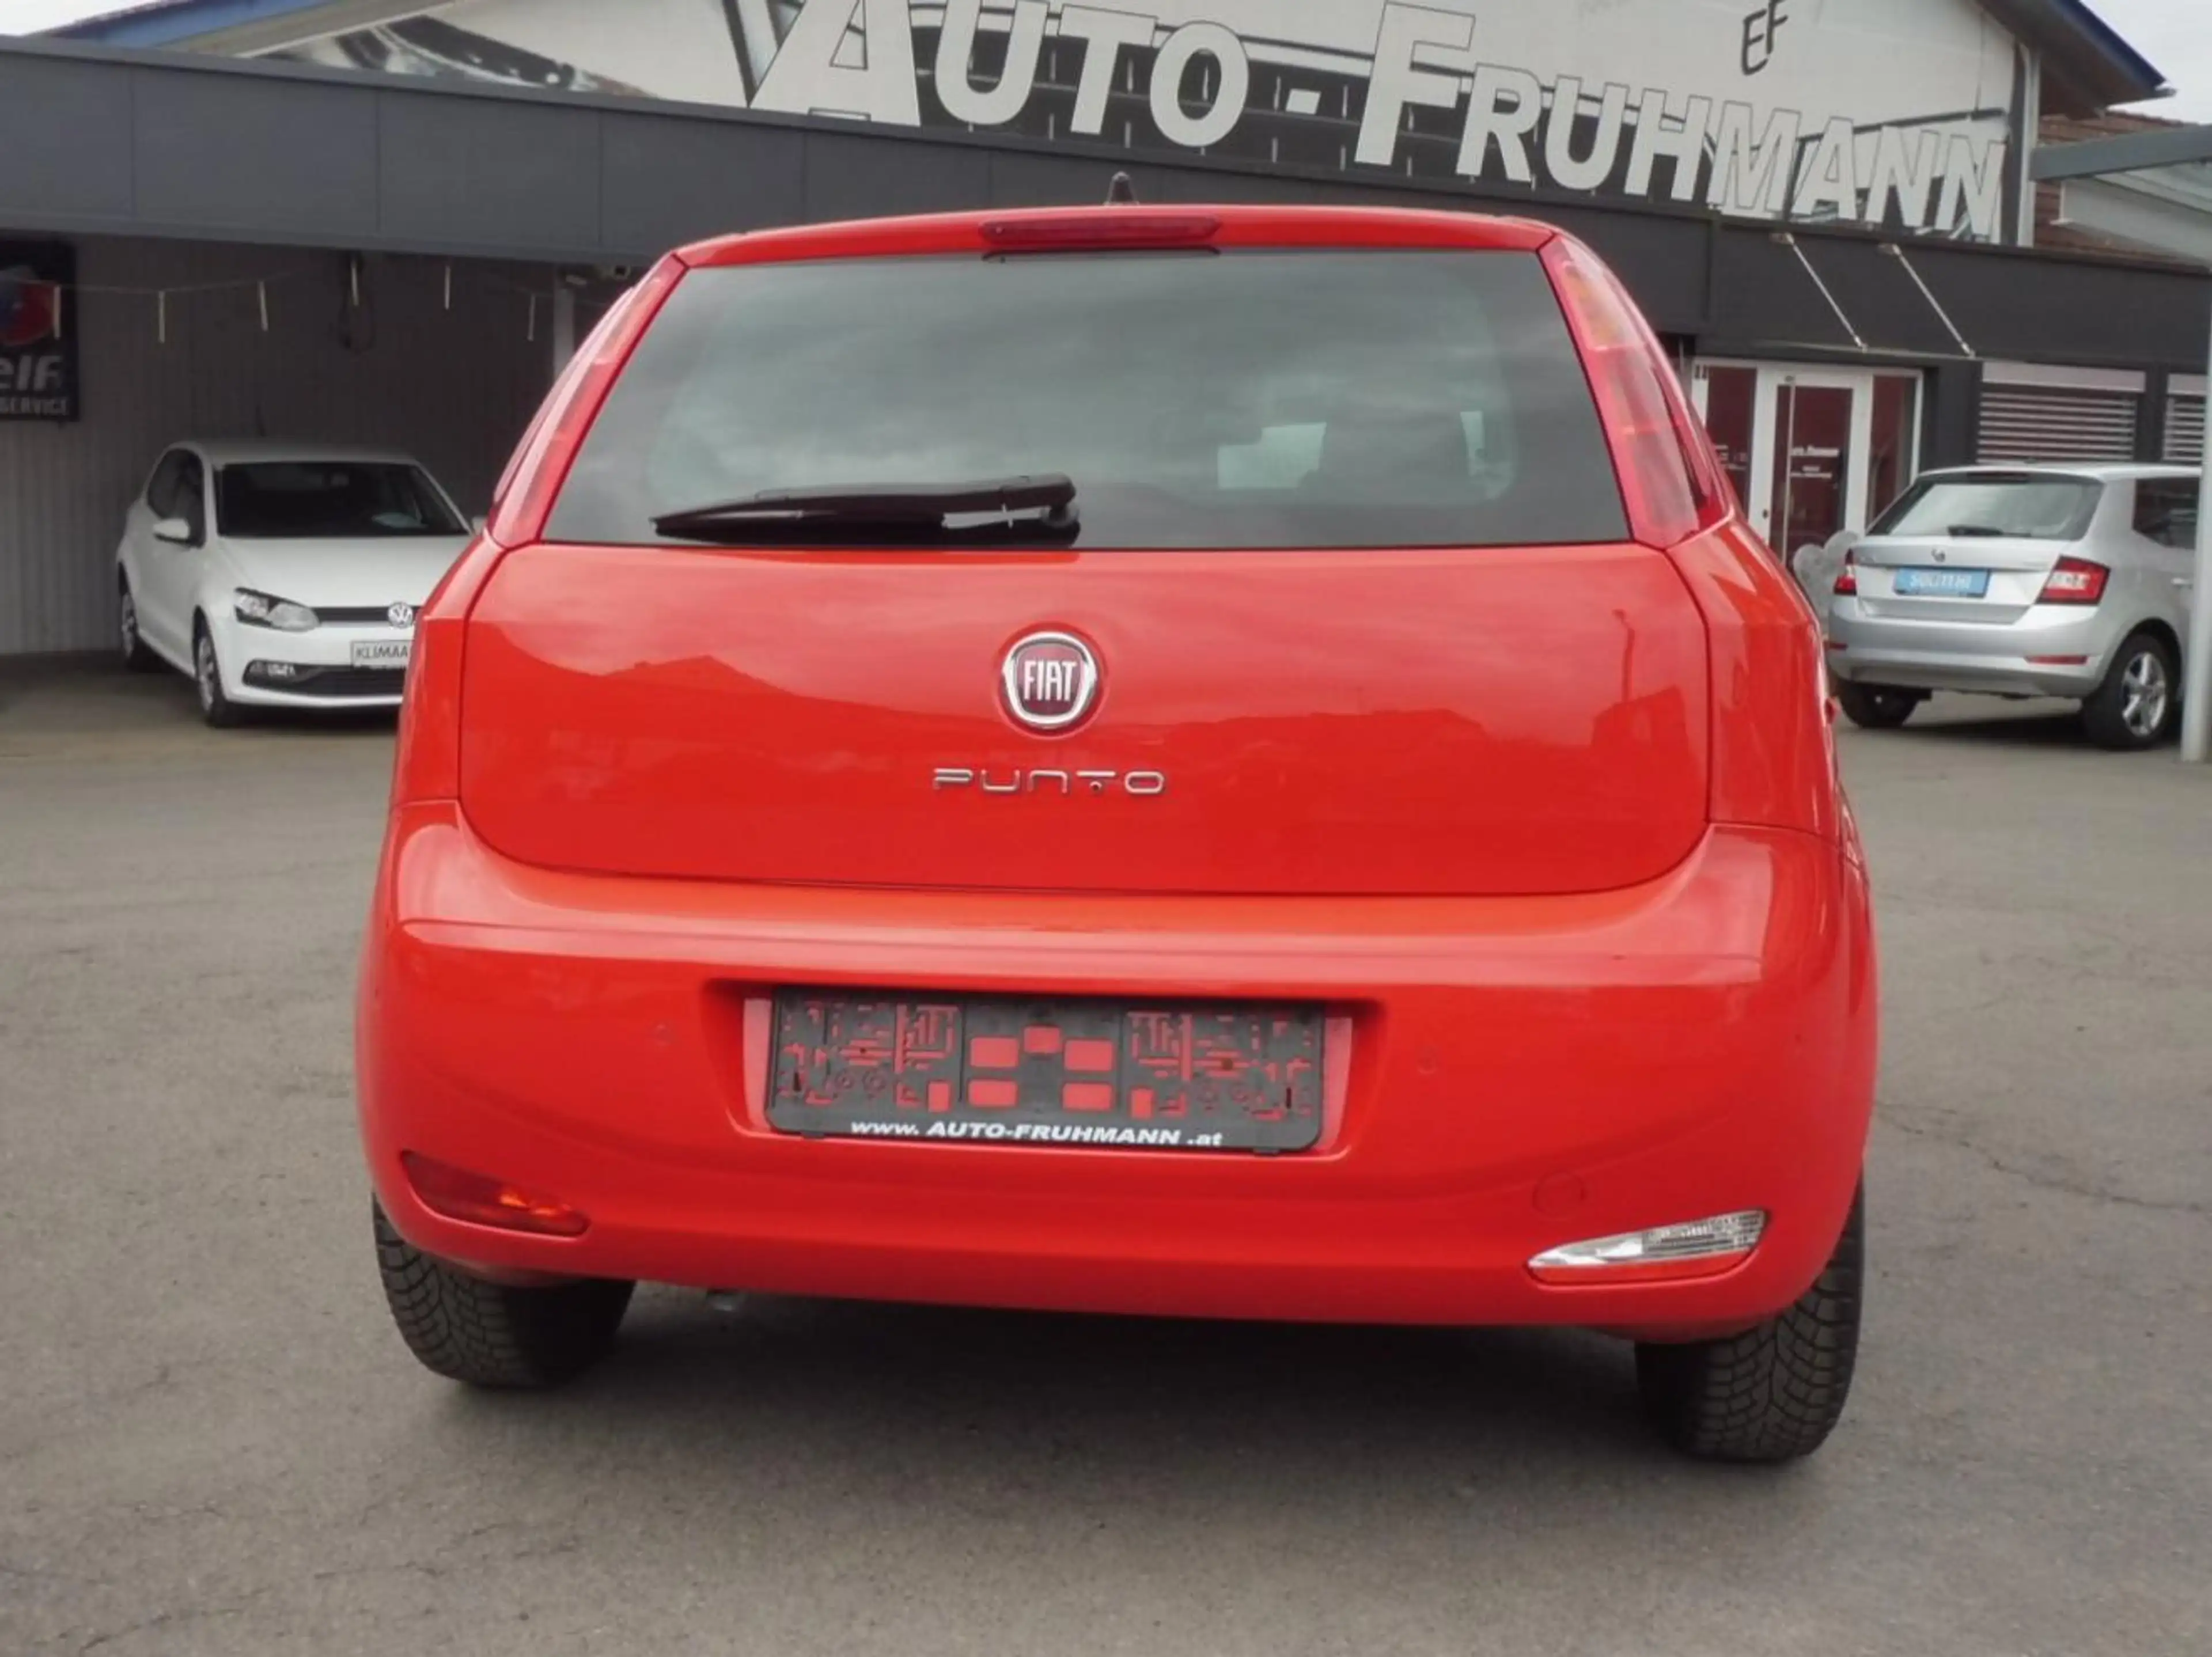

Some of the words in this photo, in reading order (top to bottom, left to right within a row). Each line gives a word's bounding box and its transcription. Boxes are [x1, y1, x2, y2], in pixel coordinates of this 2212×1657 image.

[1024, 660, 1077, 701] FIAT
[932, 768, 1165, 794] PUNTO
[926, 1121, 1181, 1145] AUTO-FRUHMANN
